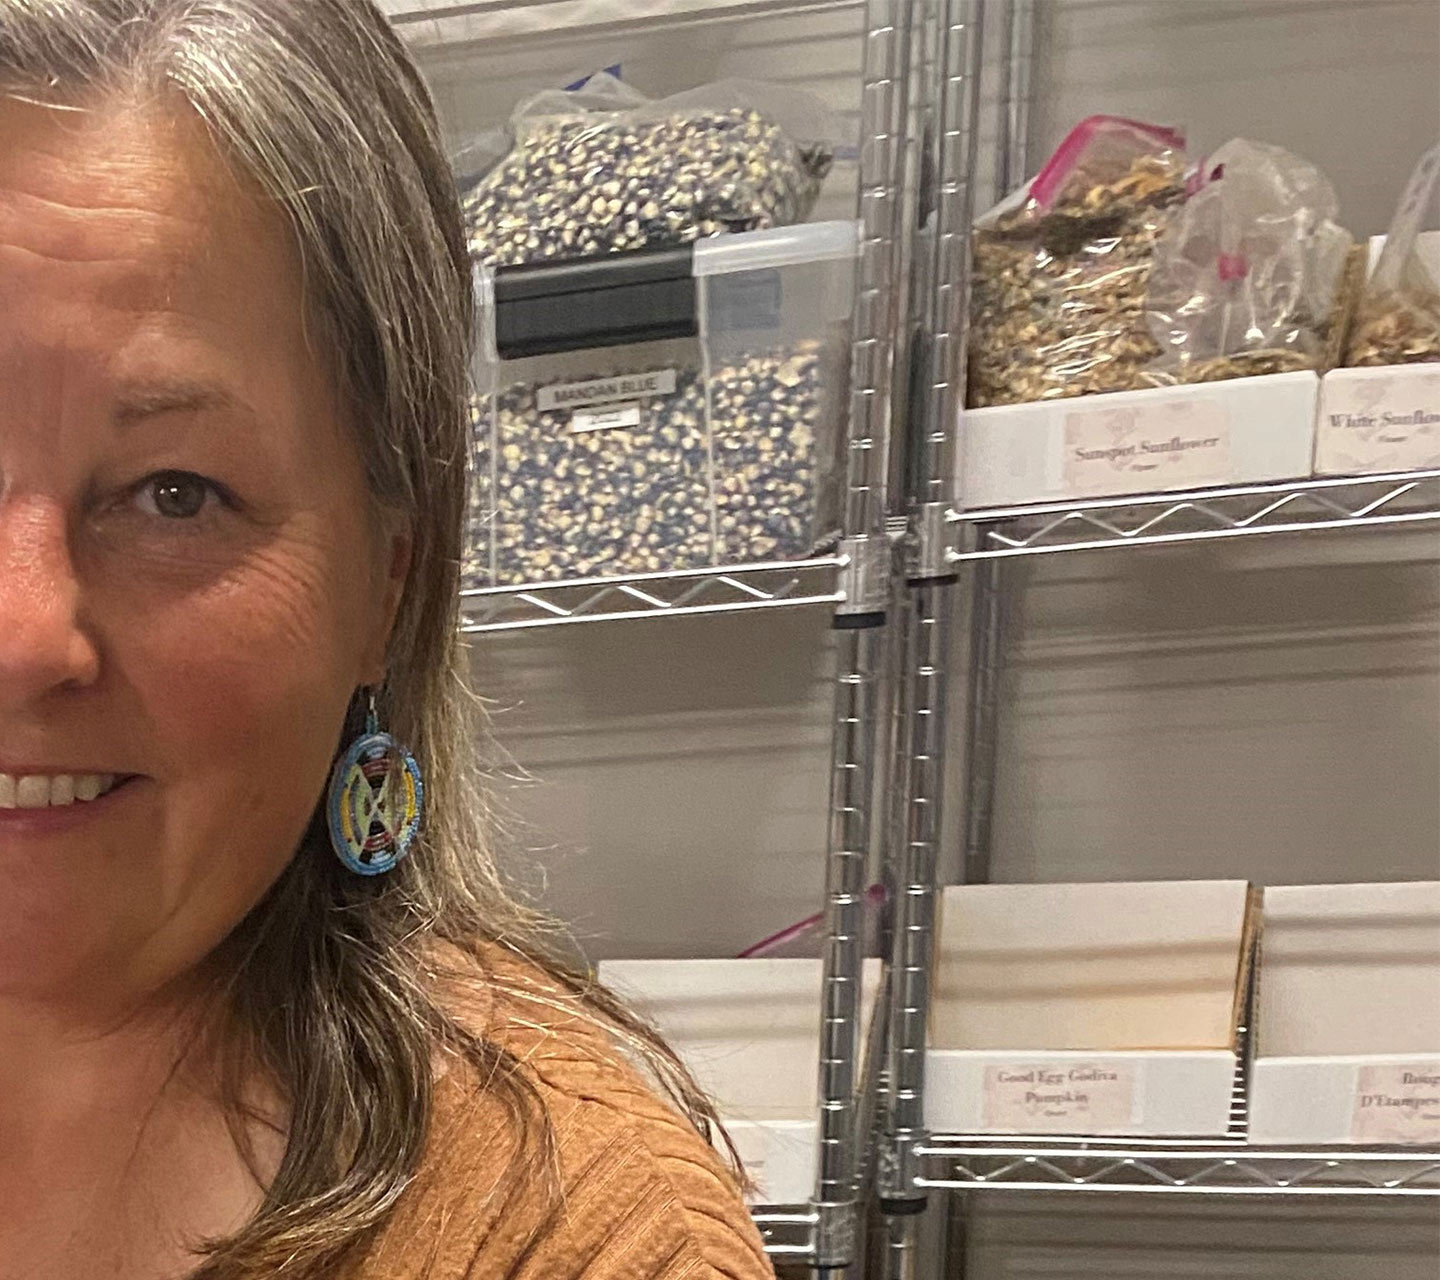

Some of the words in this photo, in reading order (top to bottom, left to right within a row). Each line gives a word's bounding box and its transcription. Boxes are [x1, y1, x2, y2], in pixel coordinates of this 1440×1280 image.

[553, 383, 618, 402] MANDAN
[620, 377, 657, 394] BLUE
[1140, 436, 1220, 454] Sunflower
[997, 1070, 1035, 1083] Good
[1037, 1070, 1065, 1085] Egg
[1067, 1068, 1118, 1082] Godiva
[1025, 1091, 1089, 1105] Pumpkin
